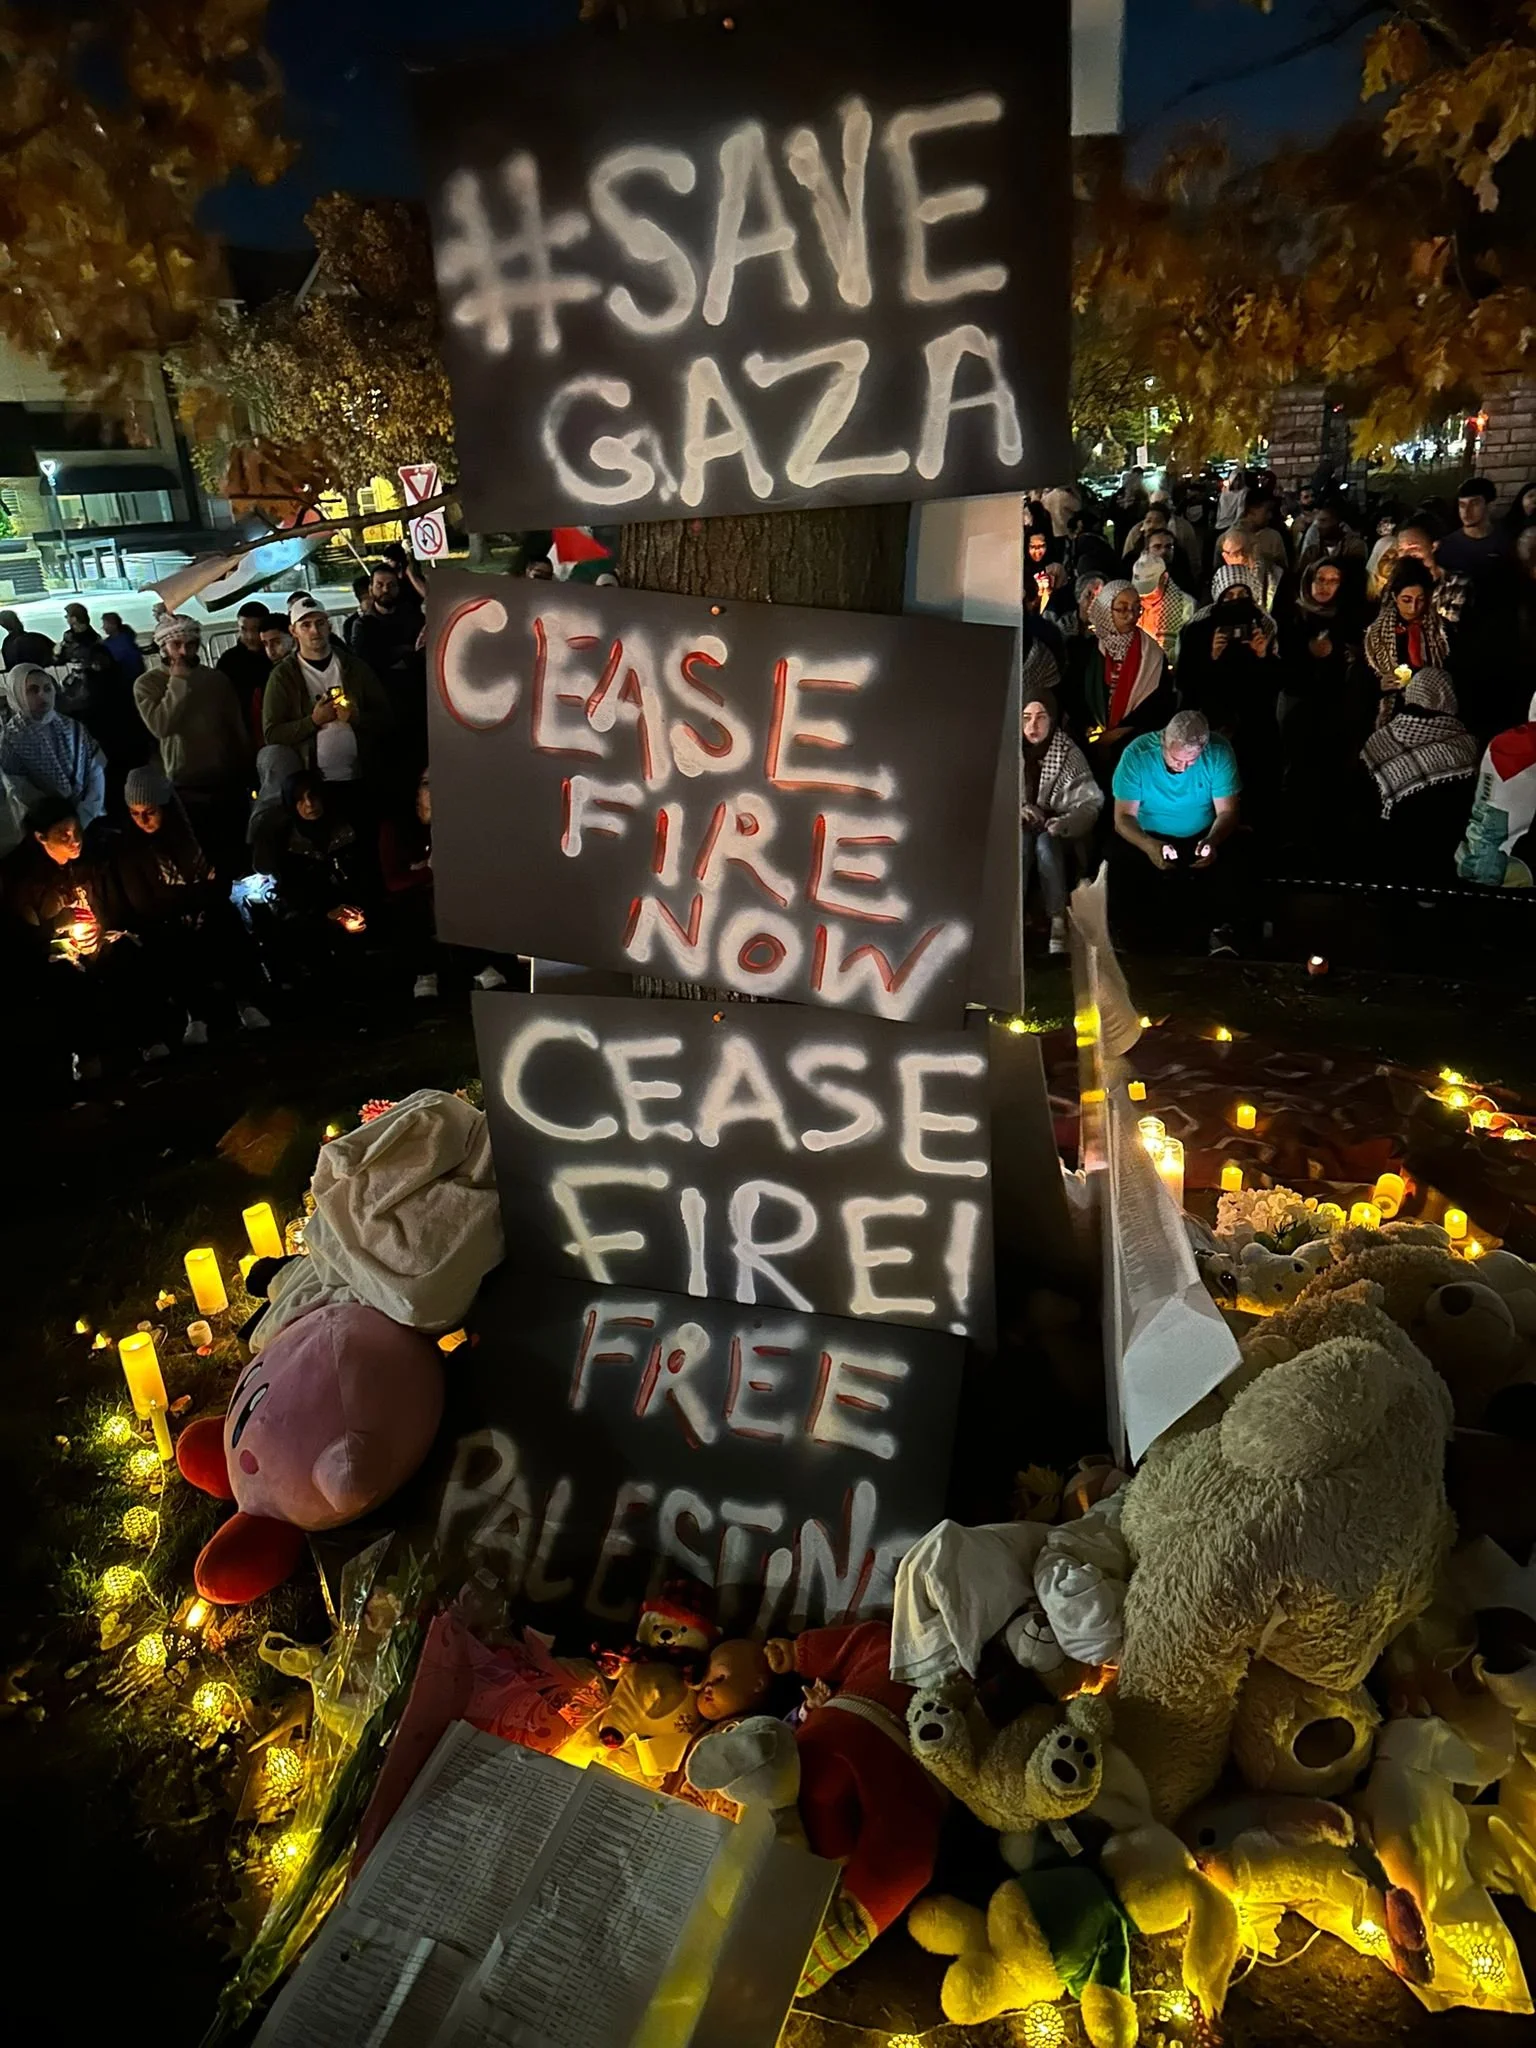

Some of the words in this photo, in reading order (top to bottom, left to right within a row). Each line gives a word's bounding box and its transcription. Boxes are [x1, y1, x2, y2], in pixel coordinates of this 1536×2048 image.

[436, 92, 1008, 353] #SAVE
[541, 324, 1023, 506] GAZA
[434, 596, 895, 799] CEASE
[559, 774, 908, 925] FIRE
[621, 892, 971, 1021] NOW
[501, 1017, 989, 1178] CEASE
[550, 1166, 981, 1335] FIRE!
[568, 1301, 910, 1460] FREE
